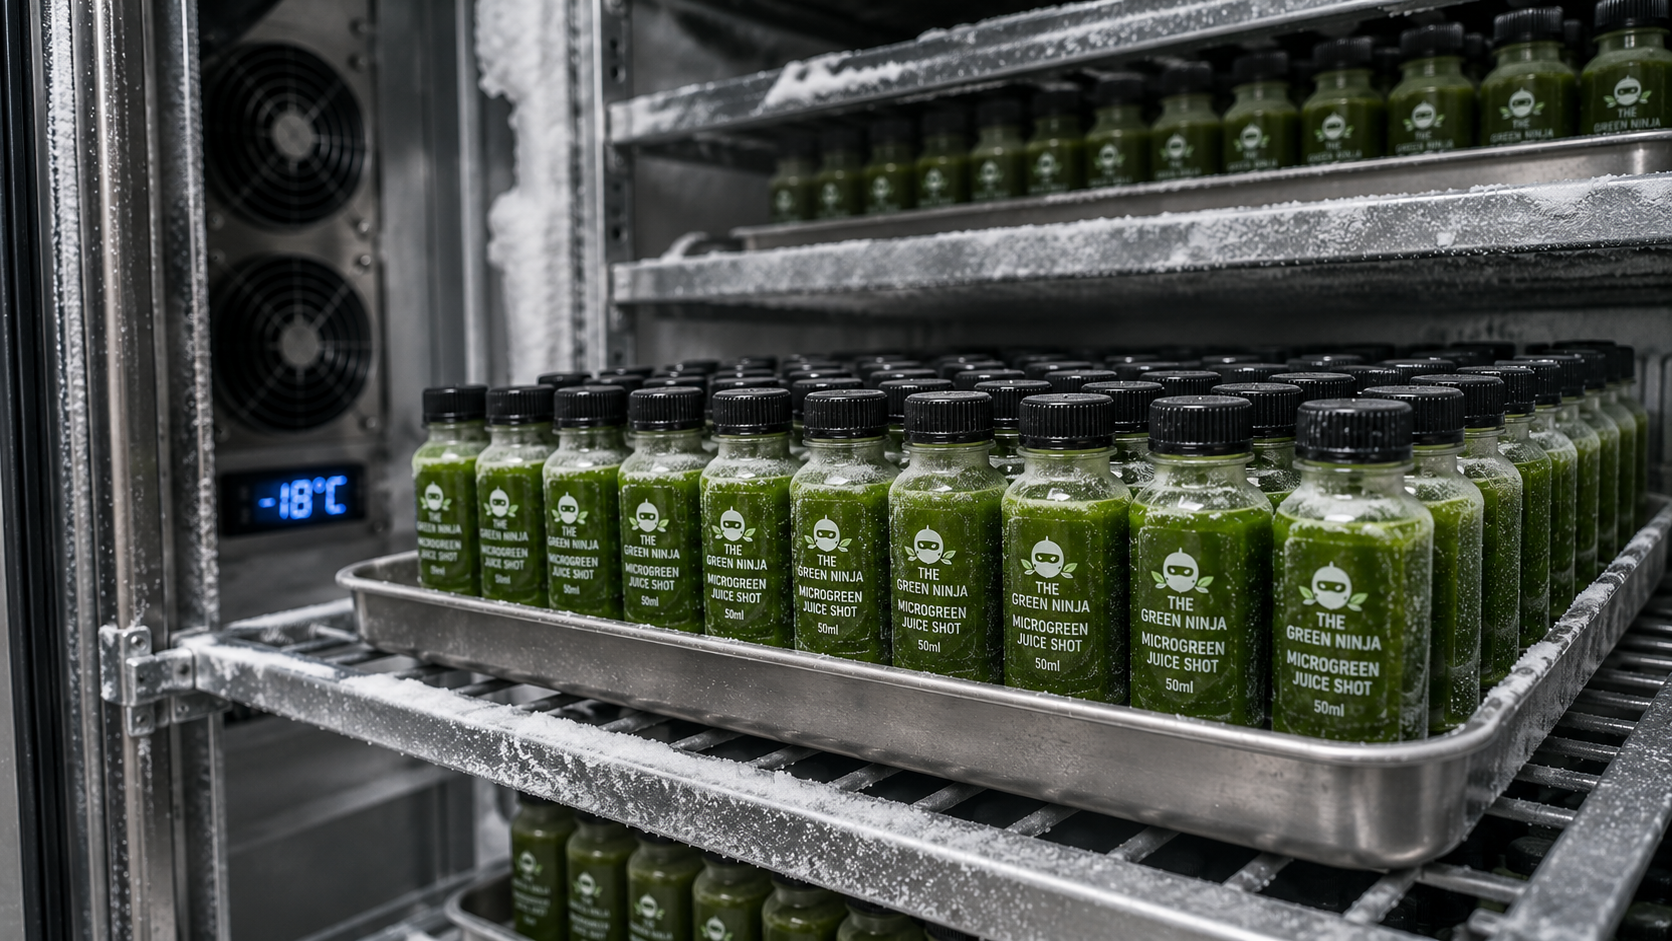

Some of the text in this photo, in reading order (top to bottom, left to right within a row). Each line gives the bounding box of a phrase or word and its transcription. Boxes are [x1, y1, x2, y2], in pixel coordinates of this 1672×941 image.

[1617, 107, 1637, 118] THE
[1512, 119, 1530, 129] THE
[1593, 117, 1661, 133] GREEN NINJA
[1525, 128, 1554, 139] NINJA
[258, 475, 347, 520] -18°C
[562, 526, 577, 537] THE
[548, 536, 599, 550] GREEN NINJA
[640, 534, 656, 546] THE
[624, 545, 680, 559] GREEN NINJA
[724, 543, 742, 556] THE
[548, 553, 598, 567] MICROGREEN
[706, 555, 768, 571] GREEN NINJA
[817, 554, 837, 568] THE
[552, 566, 594, 580] JUICE SHOT
[625, 562, 679, 578] MICROGREEN
[797, 566, 864, 583] GREEN NINJA
[918, 566, 940, 581] THE
[629, 576, 675, 591] JUICE SHOT
[707, 572, 767, 590] MICROGREEN
[897, 579, 968, 597] GREEN NINJA
[1035, 581, 1060, 596] THE
[641, 595, 659, 607] 50ml
[711, 588, 762, 604] JUICE SHOT
[799, 585, 863, 603] MICROGREEN
[803, 600, 858, 618] JUICE SHOT
[898, 599, 967, 619] MICROGREEN
[1012, 592, 1090, 613] GREEN NINJA
[1167, 595, 1194, 612] THE
[724, 607, 745, 620] 50ml
[1141, 608, 1227, 631] GREEN NINJA
[1316, 612, 1346, 630] THE
[817, 622, 839, 635] 50ml
[901, 616, 962, 635] JUICE SHOT
[1012, 614, 1088, 636] MICROGREEN
[918, 639, 941, 653] 50ml
[1017, 632, 1083, 652] JUICE SHOT
[1141, 631, 1225, 656] MICROGREEN
[1286, 625, 1382, 651] GREEN NINJA
[1035, 657, 1060, 672] 50ml
[1147, 651, 1219, 674] JUICE SHOT
[1286, 649, 1380, 678] MICROGREEN
[1165, 678, 1194, 694] 50ml
[1292, 671, 1373, 696] JUICE SHOT
[1314, 700, 1344, 718] 50ml
